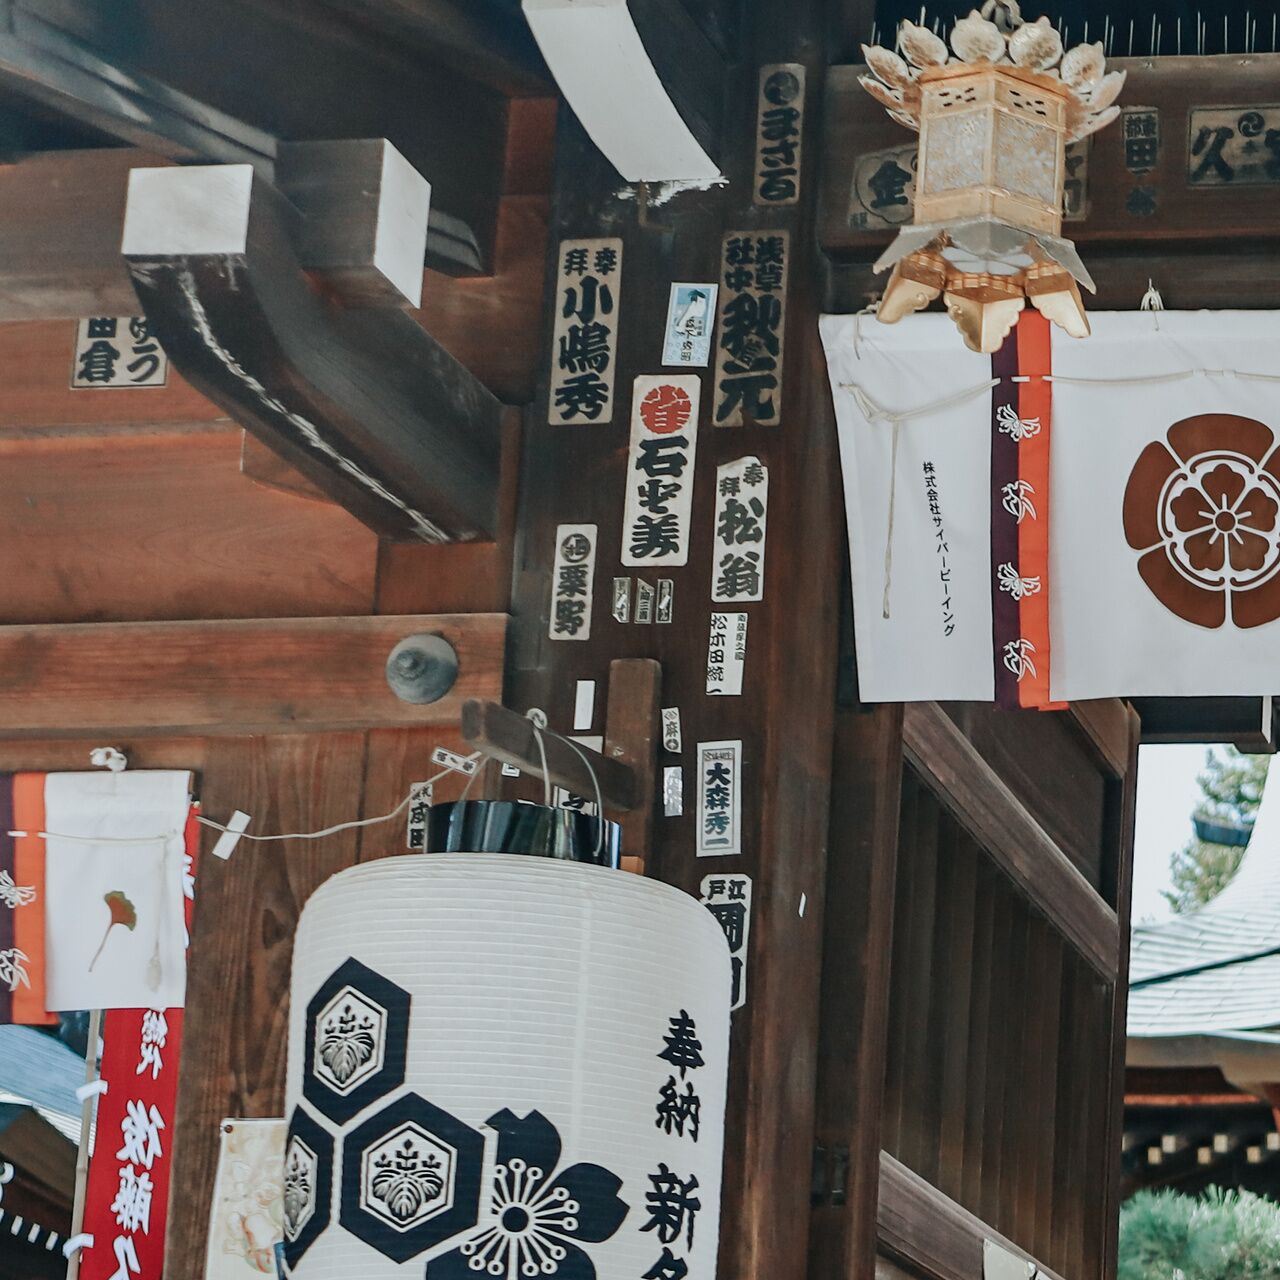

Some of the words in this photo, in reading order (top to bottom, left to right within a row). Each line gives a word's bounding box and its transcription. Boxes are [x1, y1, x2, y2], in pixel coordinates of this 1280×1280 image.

[923, 461, 955, 637] 株式会社サイバービーイング
[705, 763, 731, 845] 大森秀一
[655, 1009, 704, 1143] 奉納
